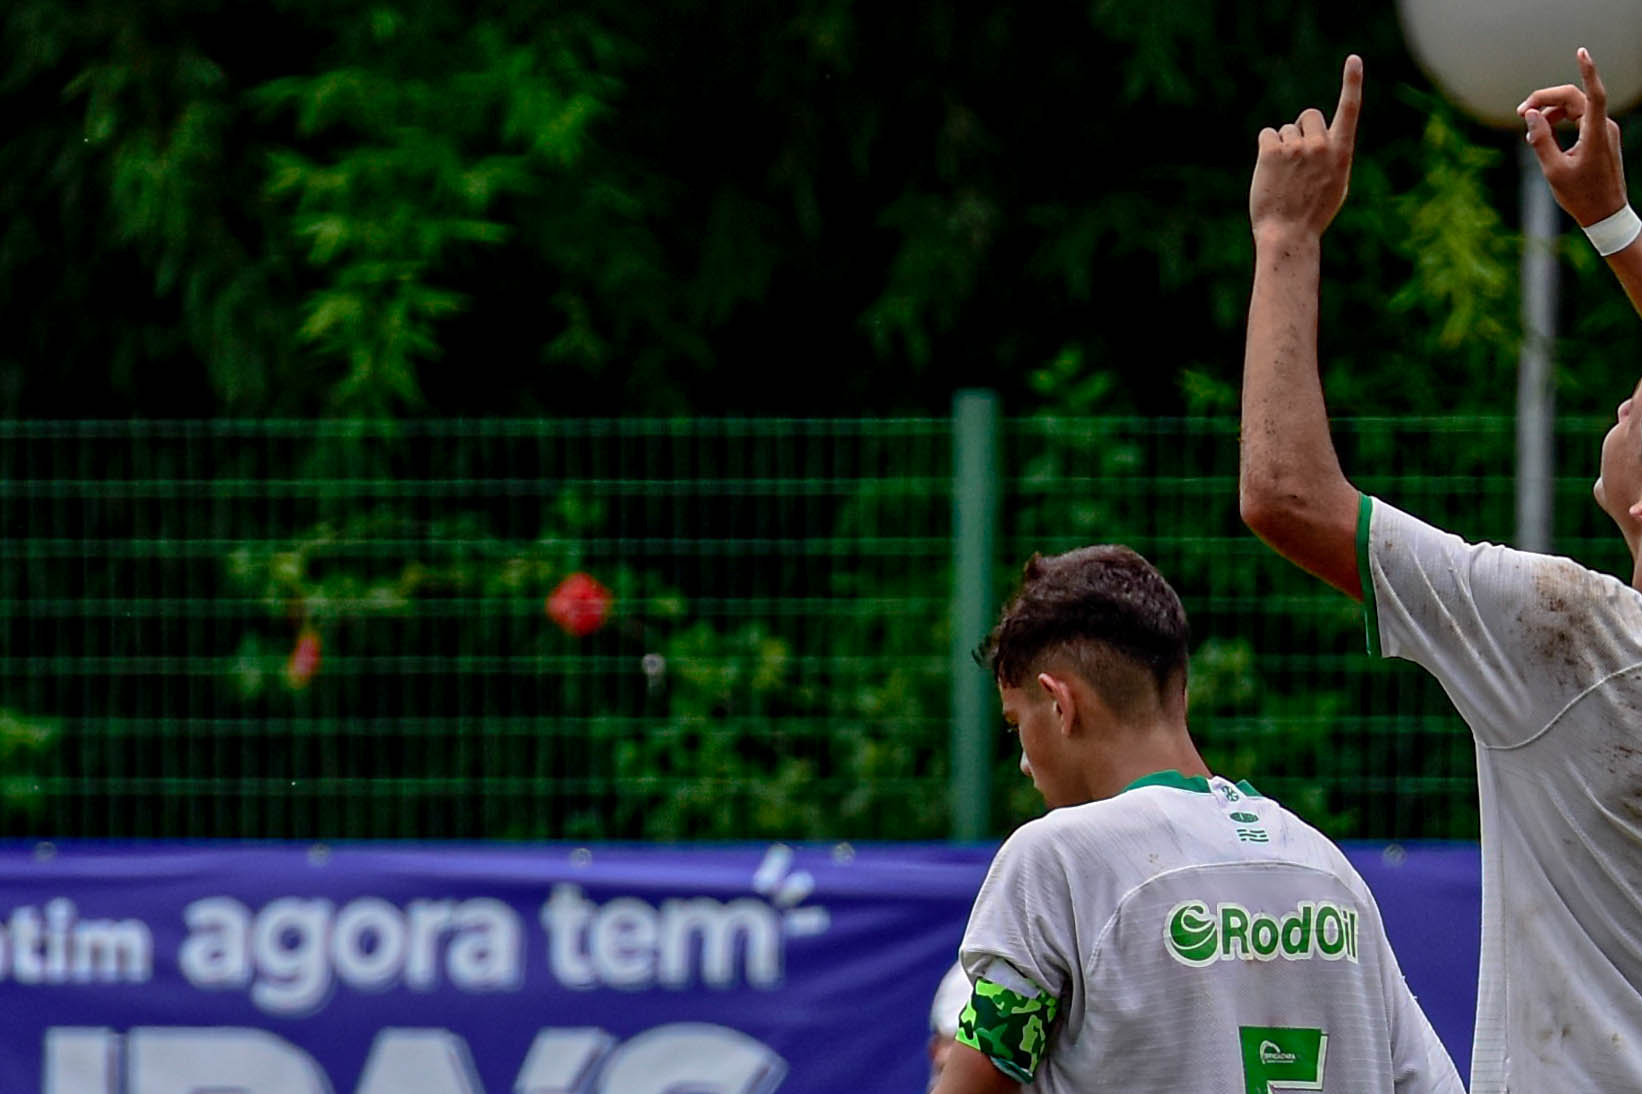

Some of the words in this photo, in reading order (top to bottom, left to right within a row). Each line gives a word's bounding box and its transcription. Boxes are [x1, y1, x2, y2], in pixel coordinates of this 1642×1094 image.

[0, 895, 153, 985] tim
[179, 896, 523, 1013] agora
[541, 883, 784, 989] tem
[1219, 903, 1358, 961] RodOil
